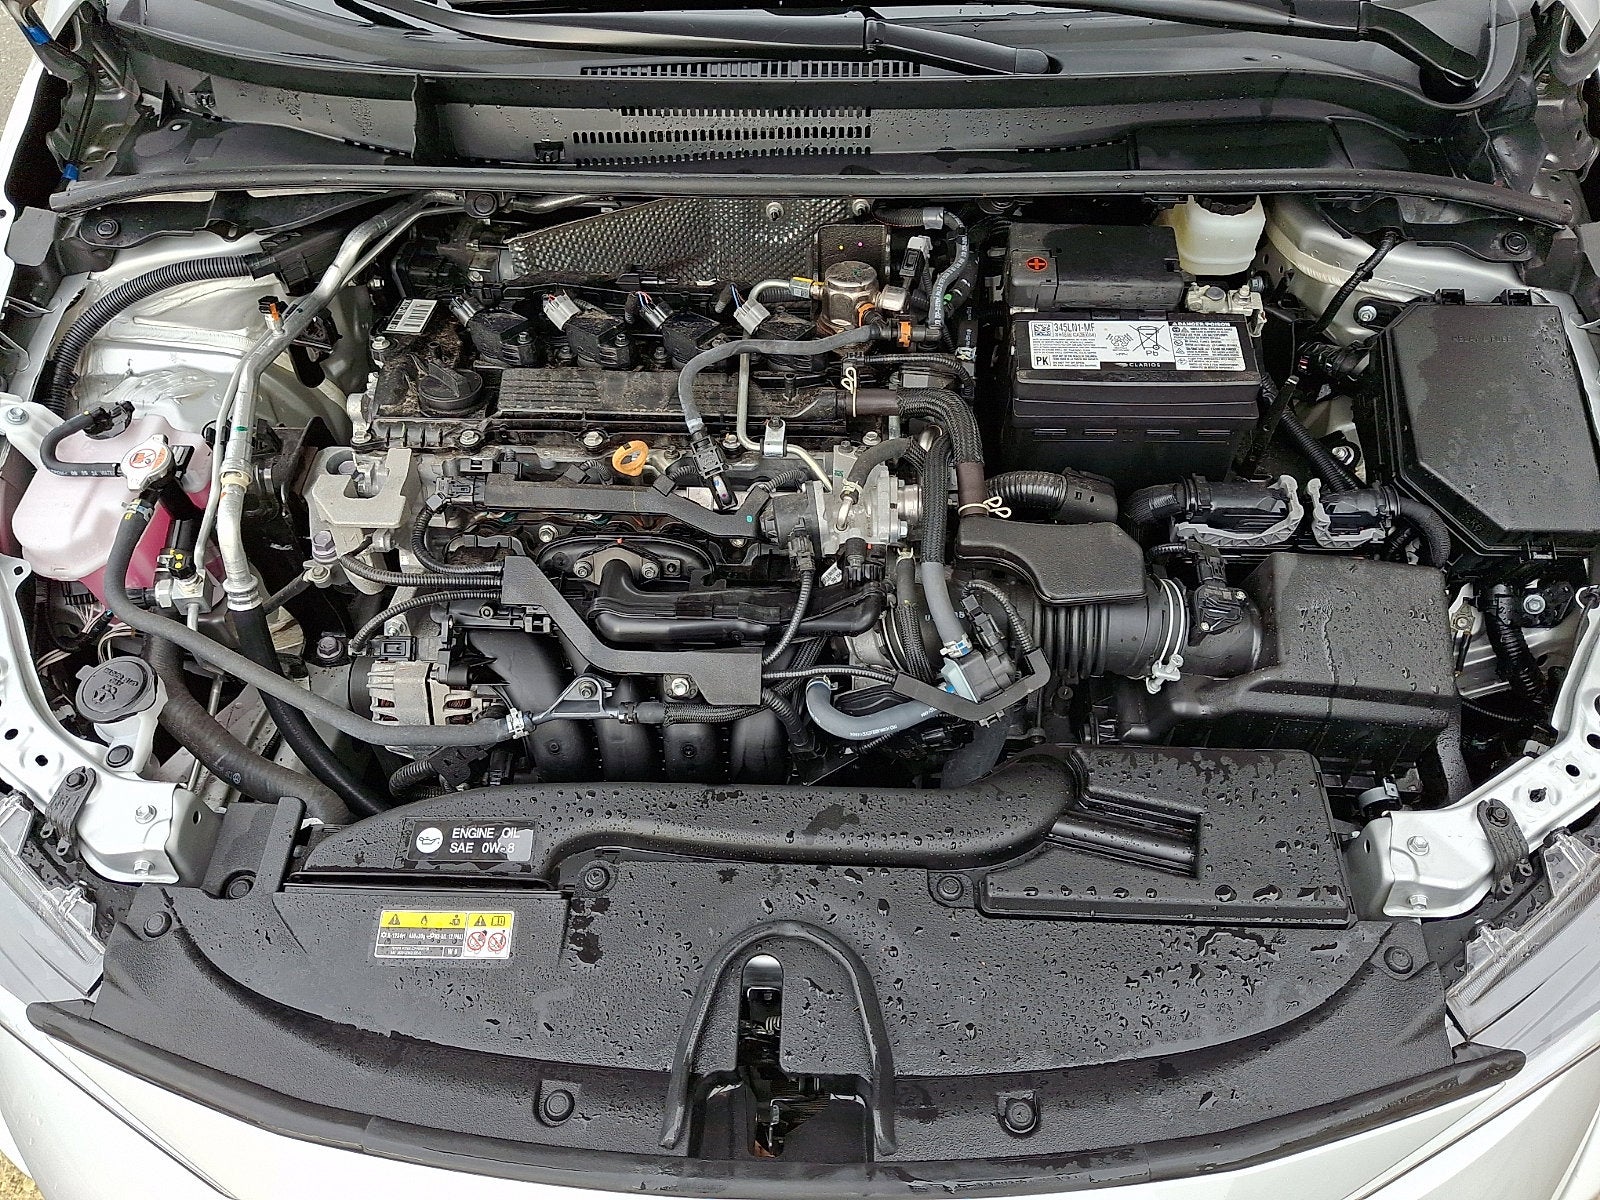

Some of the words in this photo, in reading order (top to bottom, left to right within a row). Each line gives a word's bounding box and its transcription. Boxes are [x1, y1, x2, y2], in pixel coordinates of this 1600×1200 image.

[1036, 356, 1049, 366] PK
[452, 827, 495, 839] ENGINE
[501, 827, 520, 839] OIL
[449, 842, 474, 854] SAE
[481, 842, 515, 854] 0W-8
